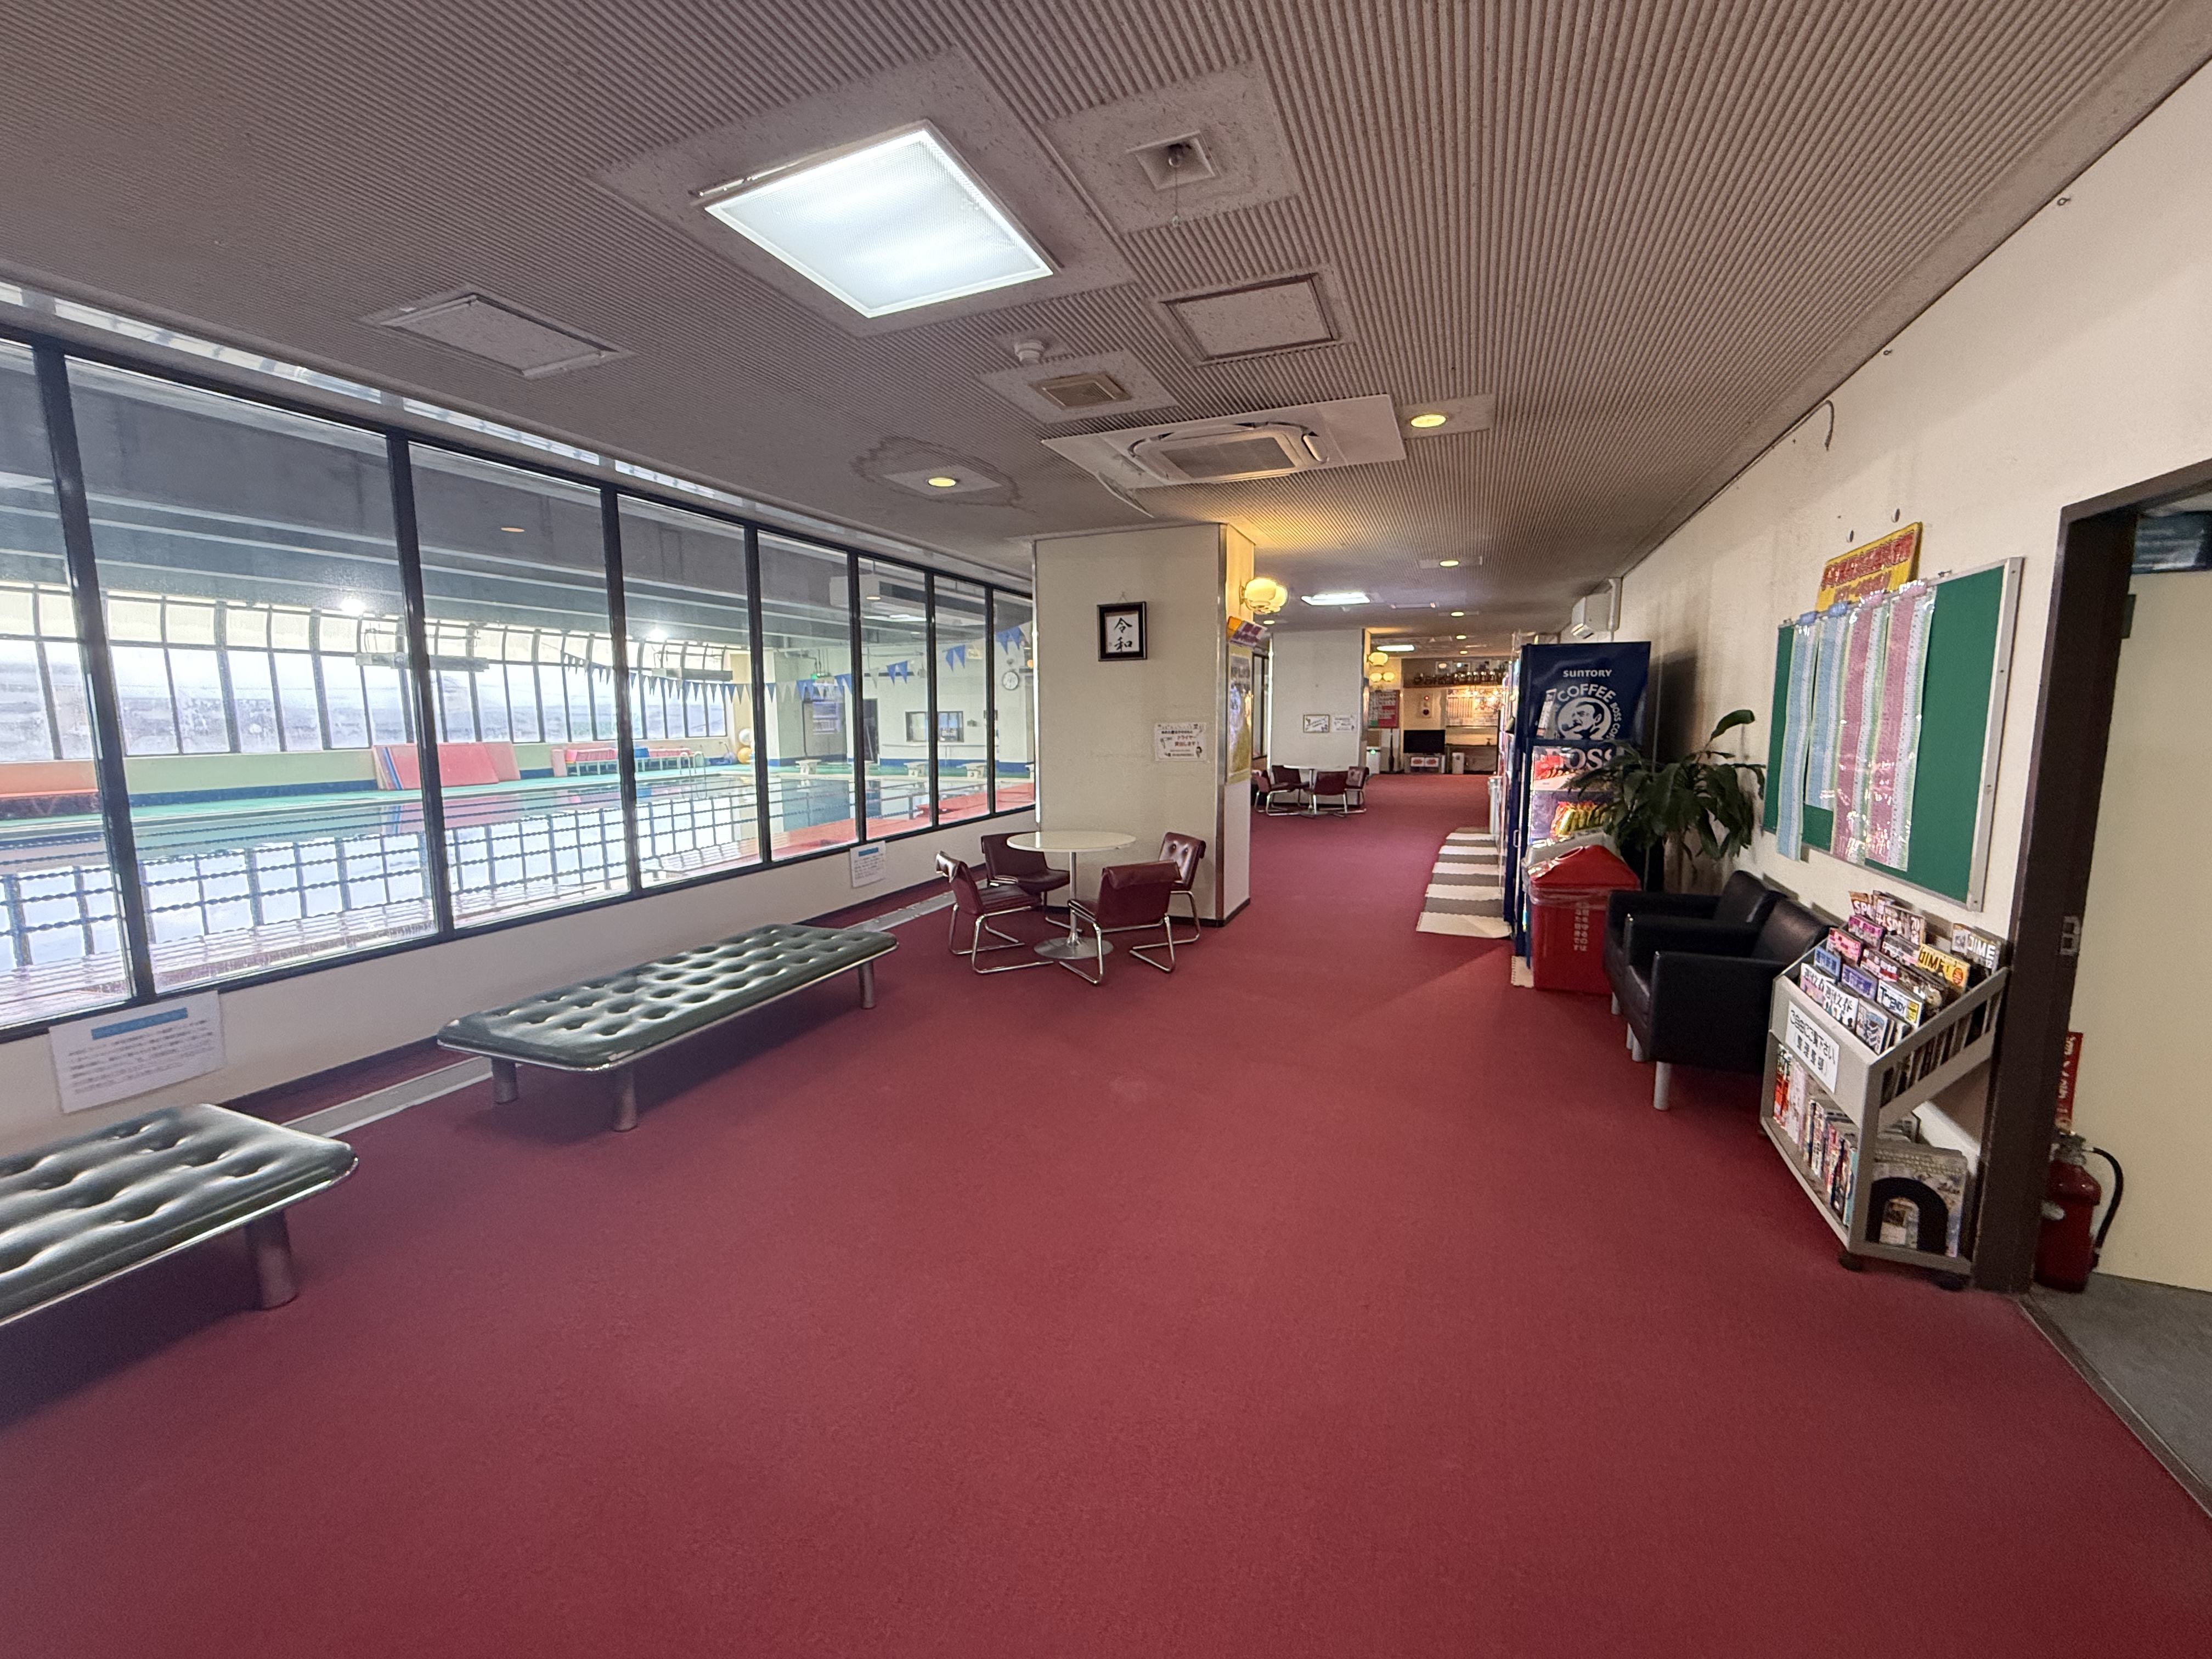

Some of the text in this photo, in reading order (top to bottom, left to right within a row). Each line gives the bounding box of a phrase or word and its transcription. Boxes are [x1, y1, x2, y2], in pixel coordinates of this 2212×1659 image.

[1113, 617, 1132, 652] 令和
[1563, 669, 1612, 678] SUNTORY
[1557, 684, 1617, 703] COFFEE
[1610, 702, 1622, 722] BOSS
